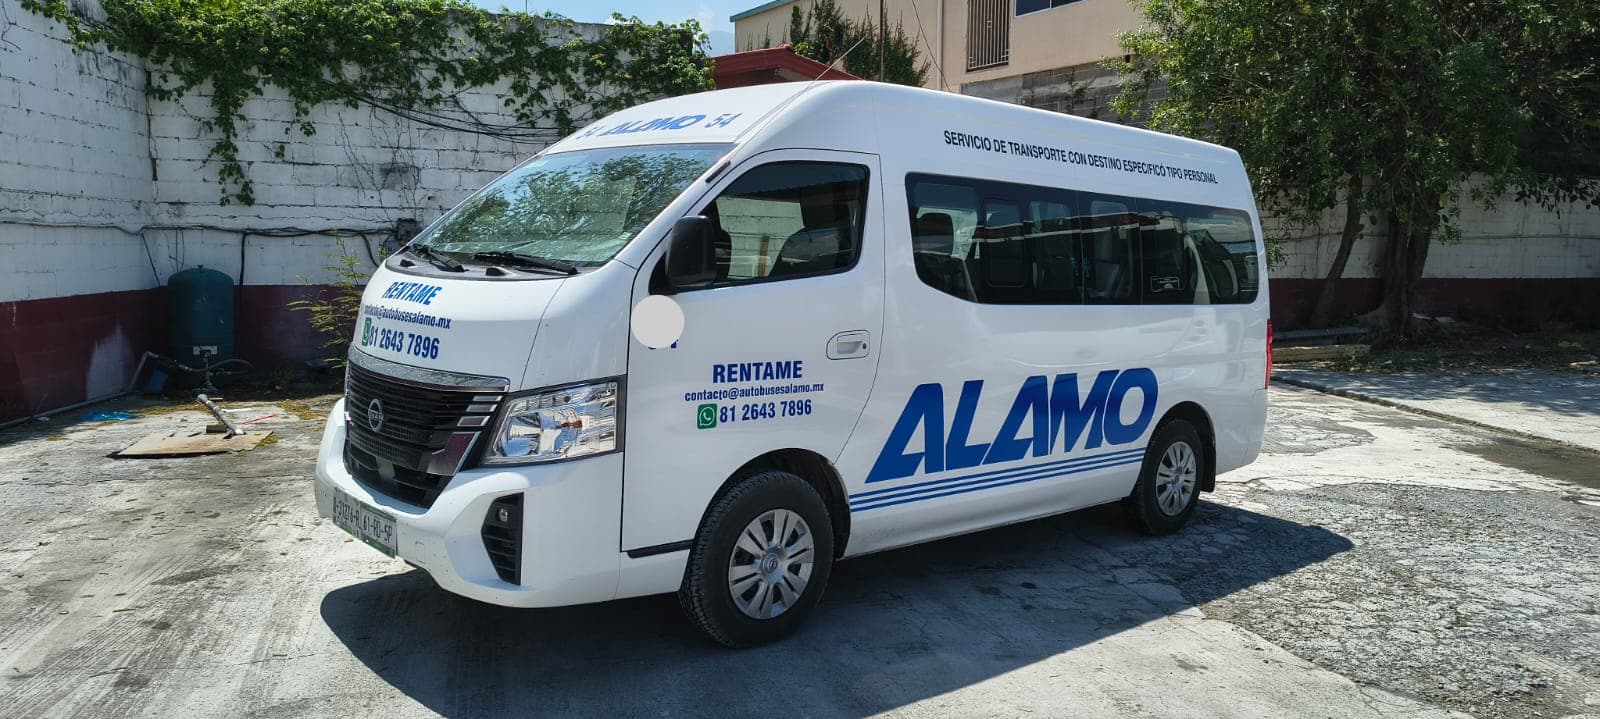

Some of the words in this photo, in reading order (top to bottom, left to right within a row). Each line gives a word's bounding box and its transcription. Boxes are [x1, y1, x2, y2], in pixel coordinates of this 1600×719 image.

[598, 114, 707, 137] ALAMO
[704, 112, 742, 129] 54
[943, 130, 992, 152] SERVICIO
[993, 138, 1007, 154] DE
[1007, 141, 1068, 163] TRANSPORTE
[1068, 150, 1087, 166] CON
[1087, 153, 1122, 171] DESTINO
[1165, 165, 1183, 180] TIPO
[1183, 168, 1219, 185] PERSONAL
[381, 281, 443, 306] RENTAME
[369, 326, 379, 347] 81
[379, 327, 404, 353] 2643
[406, 333, 440, 360] 7896
[712, 360, 803, 384] RENTAME
[684, 382, 825, 402] contacto@autobusesalamo.mx
[719, 405, 737, 424] 81
[741, 401, 776, 422] 2643
[780, 399, 812, 418] 7896
[864, 367, 1159, 484] ALAMO
